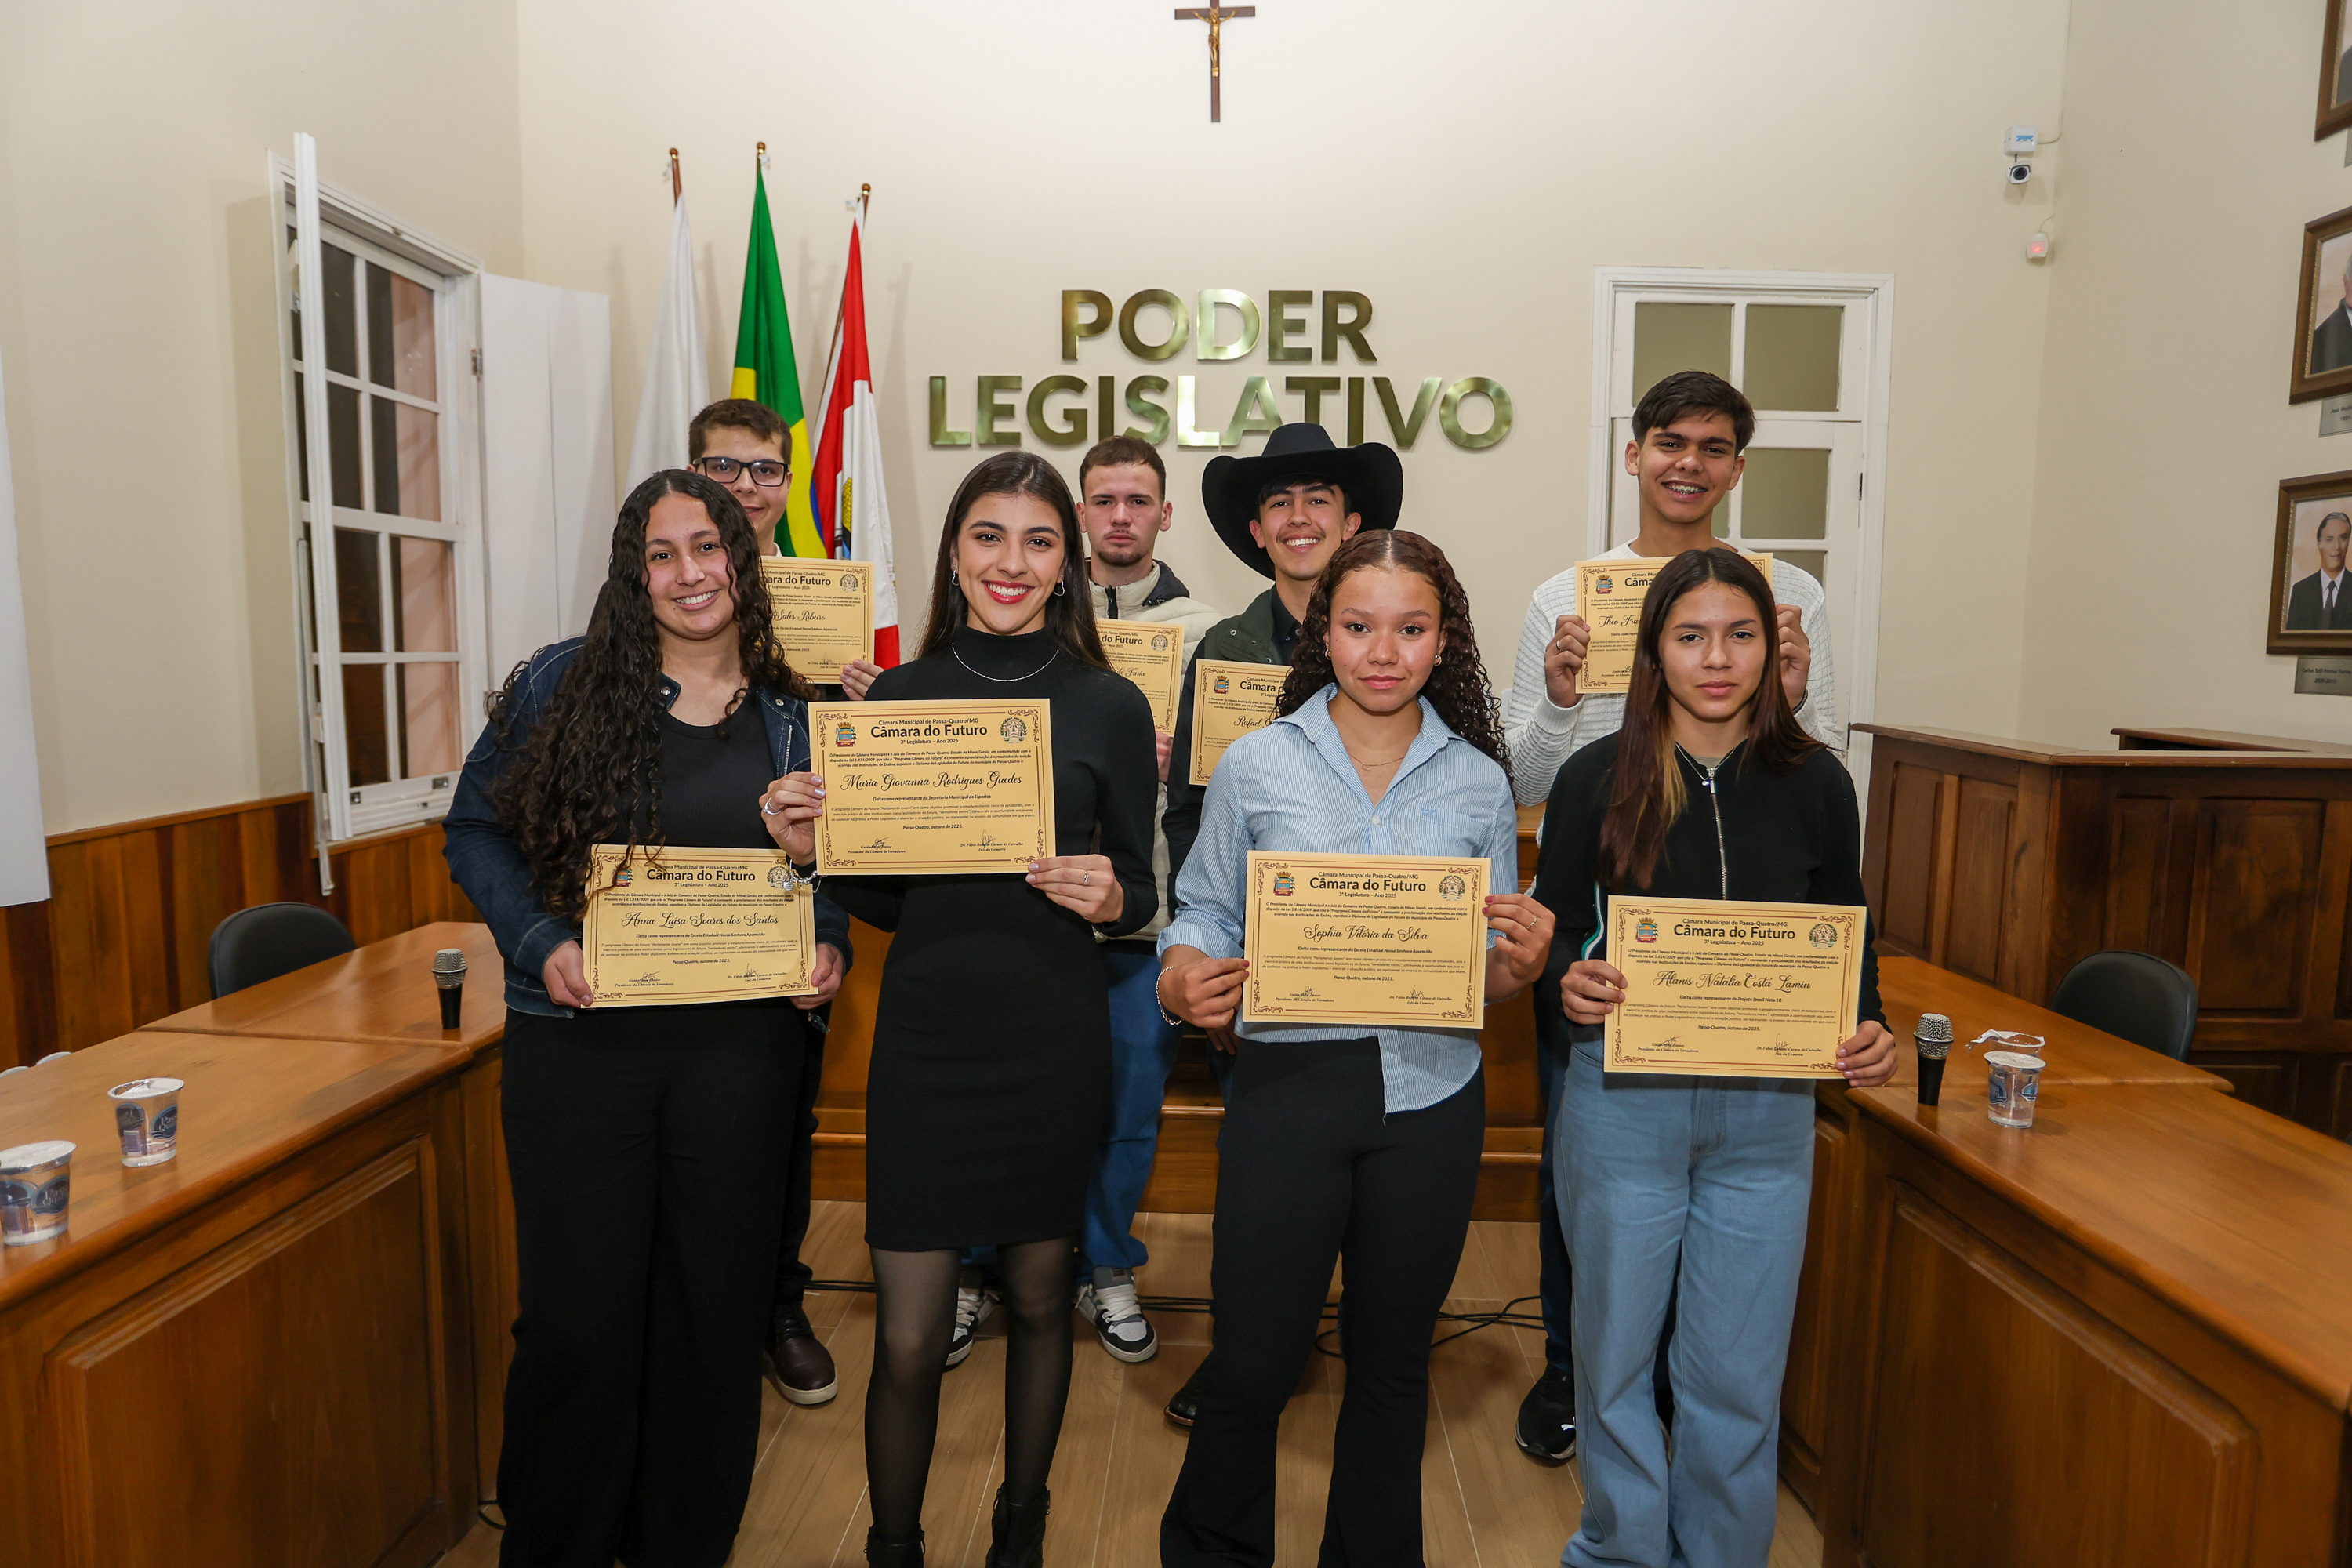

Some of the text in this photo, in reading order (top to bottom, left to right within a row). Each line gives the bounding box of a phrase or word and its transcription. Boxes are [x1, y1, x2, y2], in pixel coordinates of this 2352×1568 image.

[1062, 289, 1377, 362] PODER
[928, 375, 1513, 448] LEGISLATIVO
[786, 575, 797, 584] do
[800, 576, 831, 586] Futuro
[1624, 577, 1653, 586] Câma
[797, 610, 826, 622] Ribeiro
[1115, 636, 1143, 645] Futuro
[1240, 681, 1276, 692] Câmara
[1233, 715, 1262, 729] Rafael
[870, 724, 987, 738] Câmara do Futuro
[840, 771, 1022, 791] Maria Giovanna Rodrigues Guedes
[647, 869, 755, 881] Câmara do Futuro
[1309, 877, 1426, 891] Câmara do Futuro
[620, 911, 655, 927] Anna
[689, 912, 723, 927] Soares
[726, 914, 740, 924] dos
[743, 912, 779, 926] Santos
[1303, 924, 1428, 942] Sophia Vitória da Silva
[1673, 924, 1795, 939] Câmara do Futuro
[1652, 970, 1811, 993] Alanis Natalia Costa Lamin
